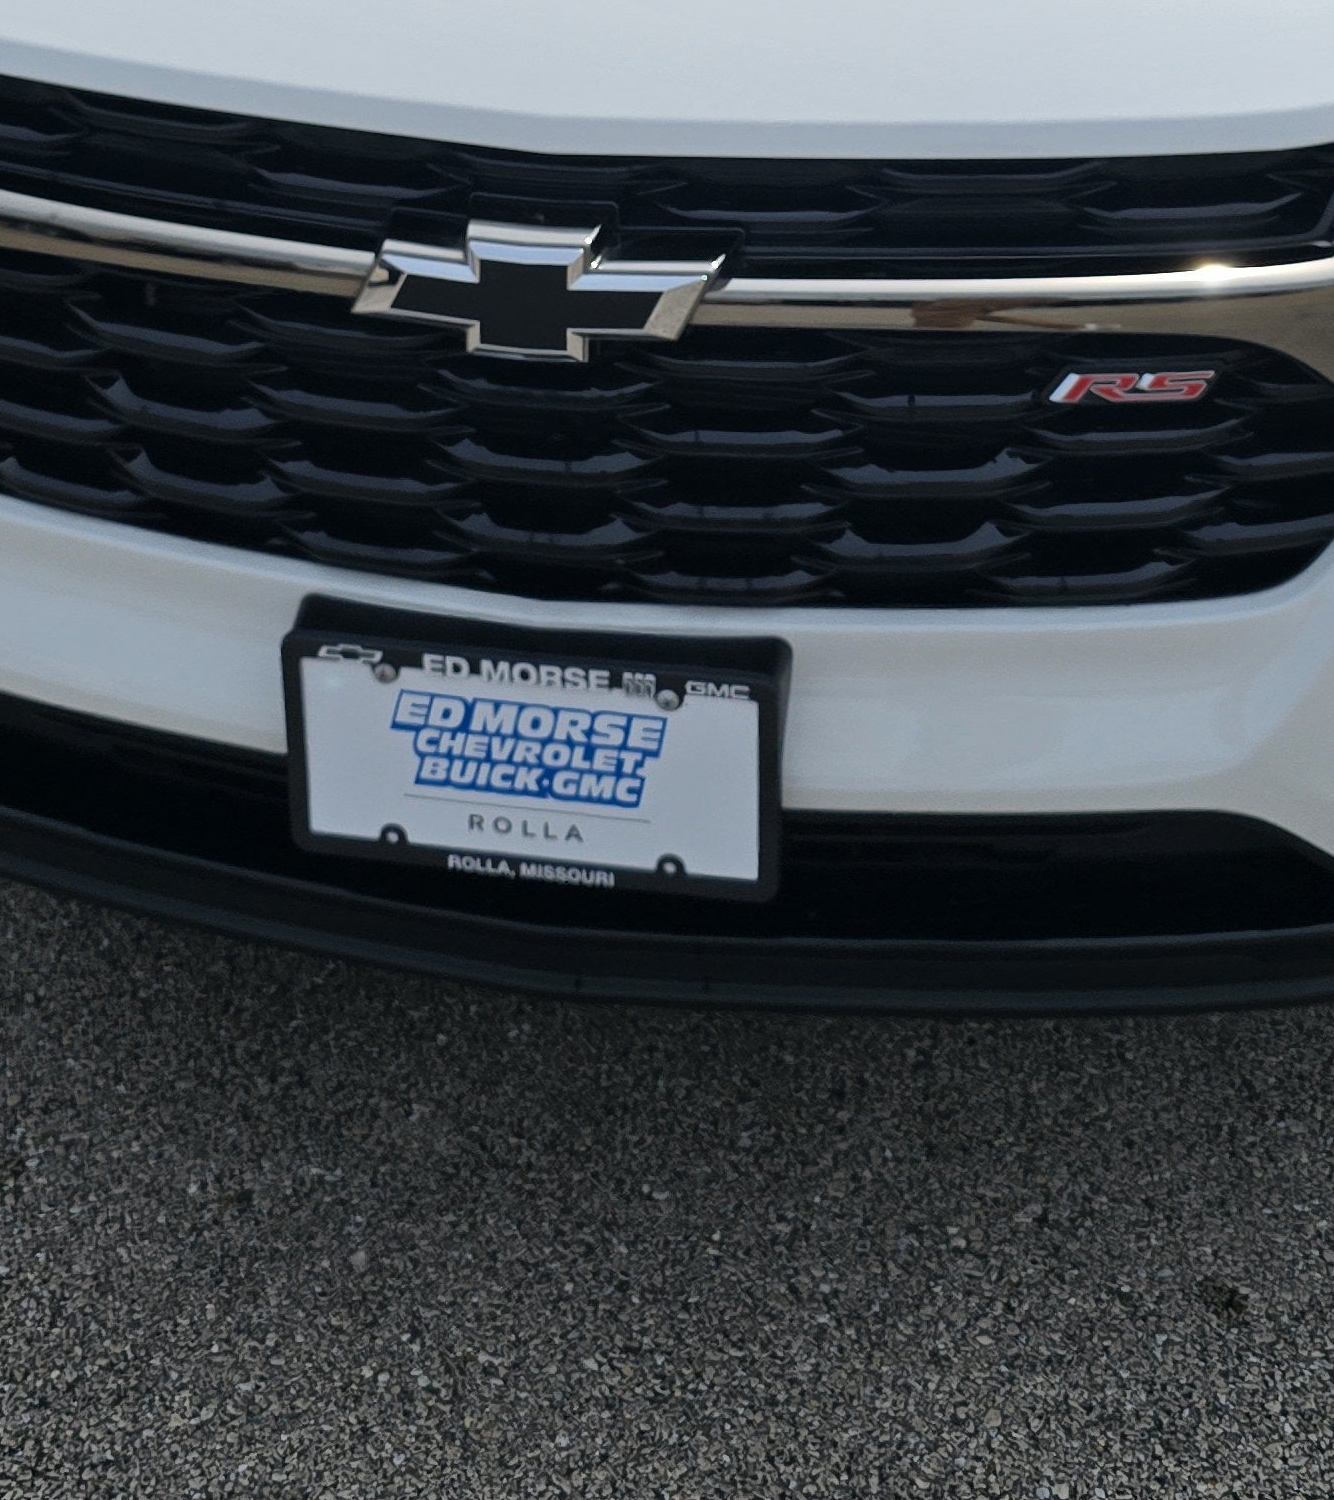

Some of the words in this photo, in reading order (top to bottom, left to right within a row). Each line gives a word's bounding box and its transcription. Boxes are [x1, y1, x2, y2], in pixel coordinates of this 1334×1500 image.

[1049, 369, 1216, 403] RS
[422, 653, 470, 677] ED
[480, 658, 610, 692] MORSE
[684, 680, 750, 701] GMC
[394, 693, 466, 729] ED
[470, 700, 664, 751] MORSE
[468, 813, 584, 843] ROLLA
[447, 853, 516, 879] ROLLA,
[519, 862, 615, 888] MISSOURI
